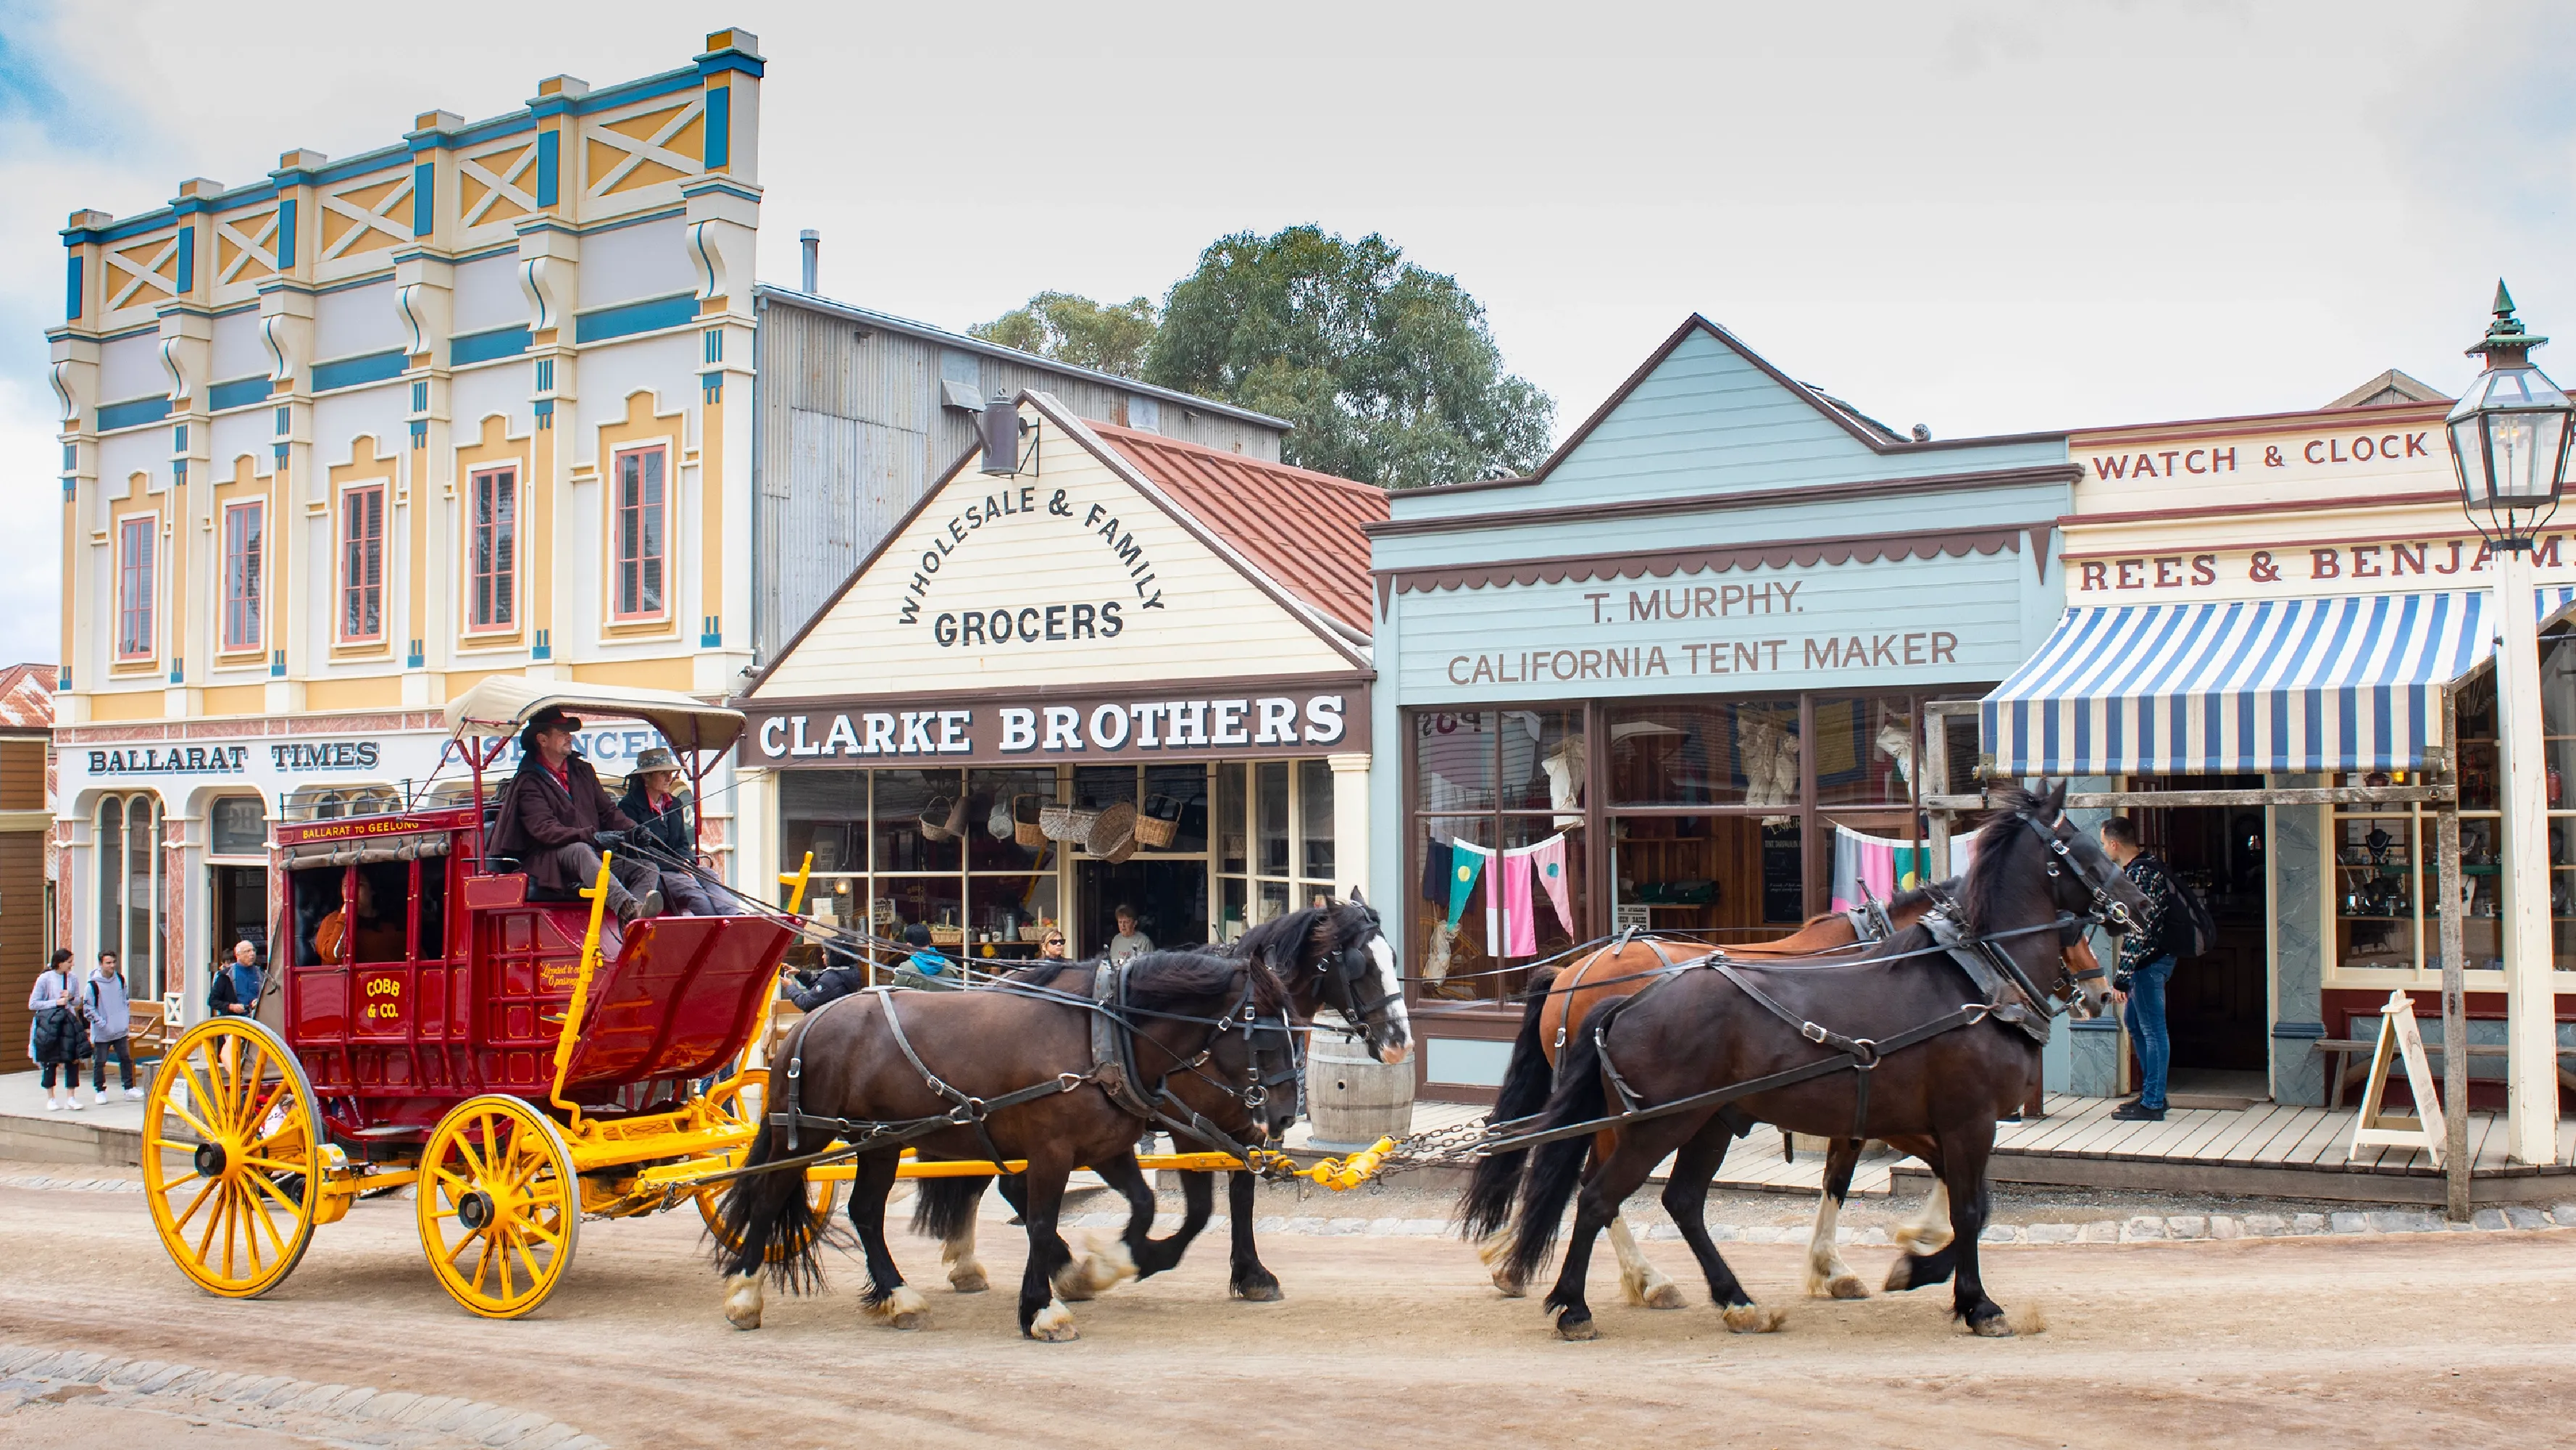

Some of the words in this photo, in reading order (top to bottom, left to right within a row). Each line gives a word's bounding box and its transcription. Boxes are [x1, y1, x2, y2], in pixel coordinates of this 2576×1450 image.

[2093, 446, 2236, 480] WATCH
[2264, 445, 2285, 467] &
[2304, 432, 2430, 464] CLOCK
[899, 486, 1035, 625] WHOLESALE
[1049, 488, 1073, 517] &
[1085, 503, 1164, 610] FAMILY
[2080, 554, 2217, 591] REES
[2249, 550, 2282, 583] &
[2310, 534, 2576, 580] BENJAM
[935, 601, 1123, 648] GROCERS
[1584, 592, 1613, 623] T.
[1630, 580, 1804, 622] MURPHY.
[1448, 645, 1670, 686] CALIFORNIA
[1681, 639, 1788, 675] TENT
[1804, 631, 1958, 670] MAKER
[759, 709, 974, 759] CLARKE
[998, 694, 1348, 754] BROTHERS
[88, 746, 248, 775] BALLARAT
[272, 741, 381, 772] TIMES
[302, 826, 351, 839] BALLARAT
[368, 821, 419, 833] GEELONG
[367, 978, 400, 997] COBB
[367, 1003, 376, 1018] &
[380, 1003, 399, 1018] CO.
